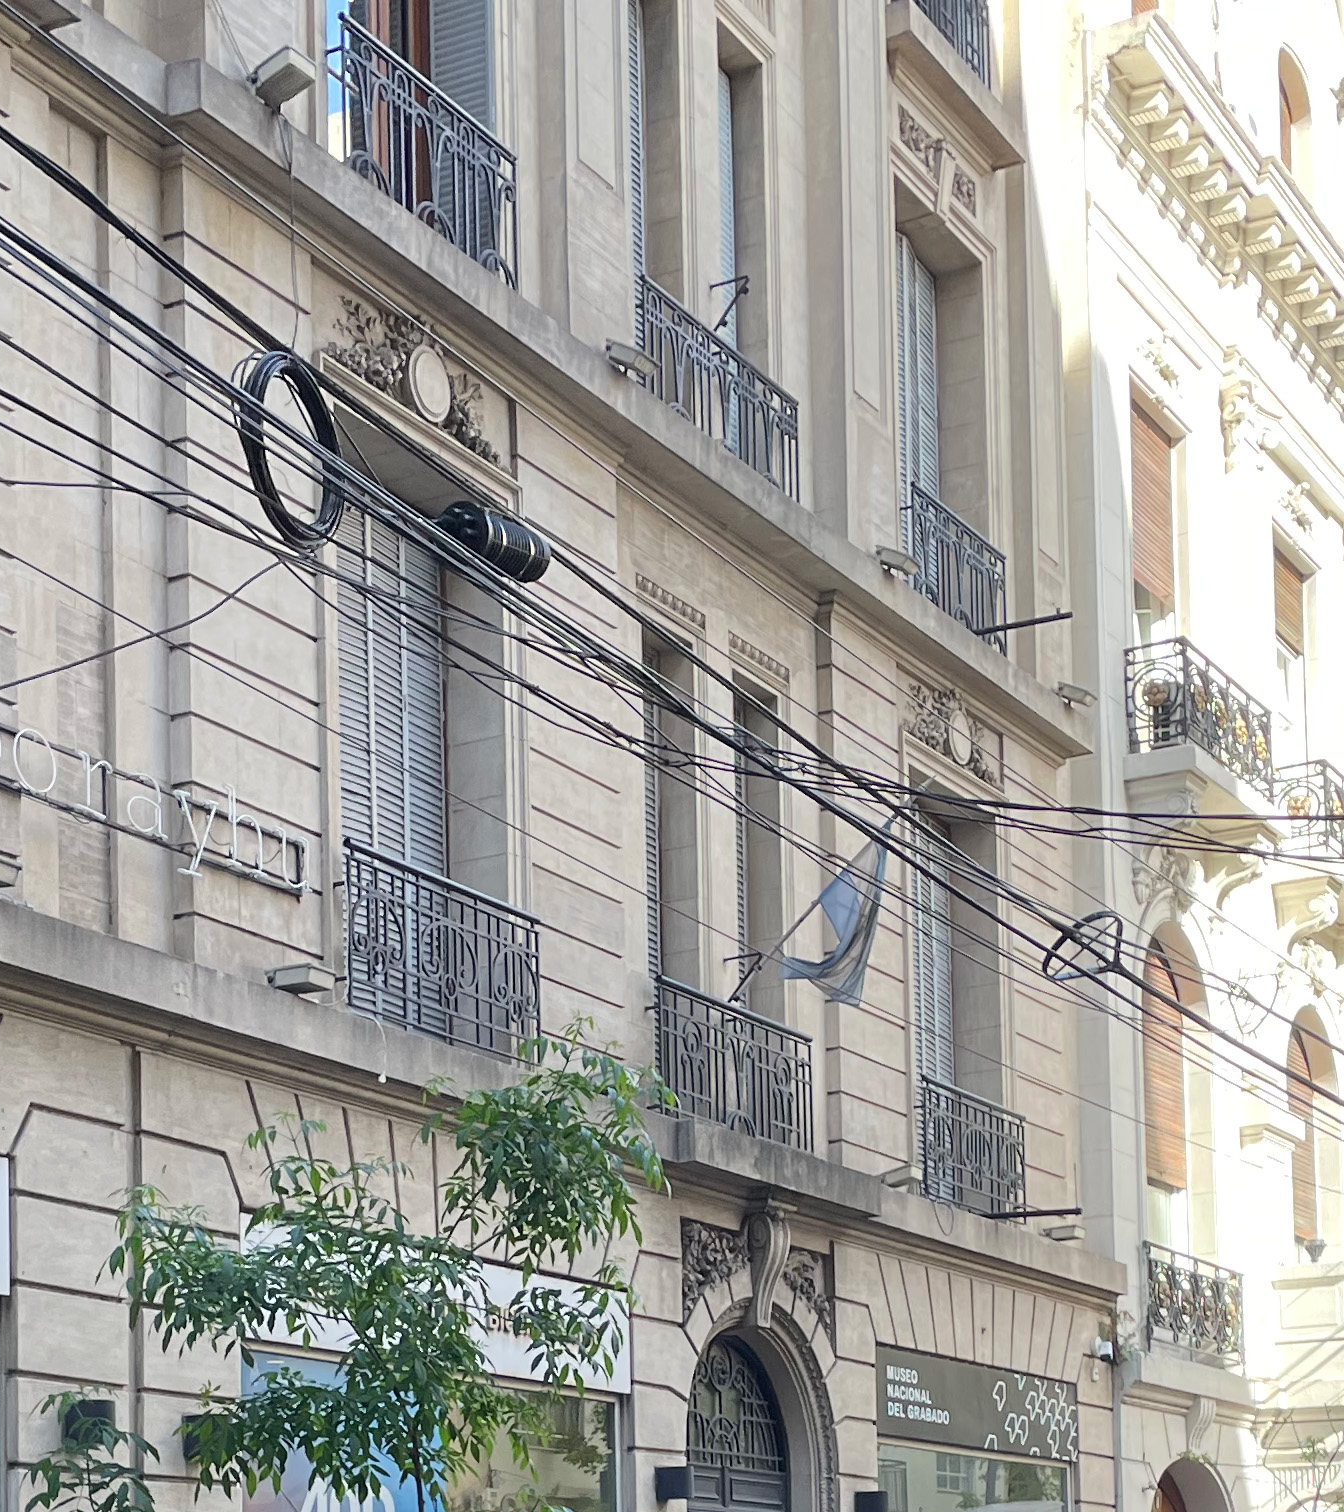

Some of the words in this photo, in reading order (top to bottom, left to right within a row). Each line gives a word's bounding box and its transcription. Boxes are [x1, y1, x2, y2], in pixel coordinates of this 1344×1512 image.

[886, 1364, 919, 1385] MUSEO
[886, 1383, 933, 1405] NACIONAL
[887, 1401, 906, 1418] DEL
[906, 1404, 950, 1425] GRABADO
